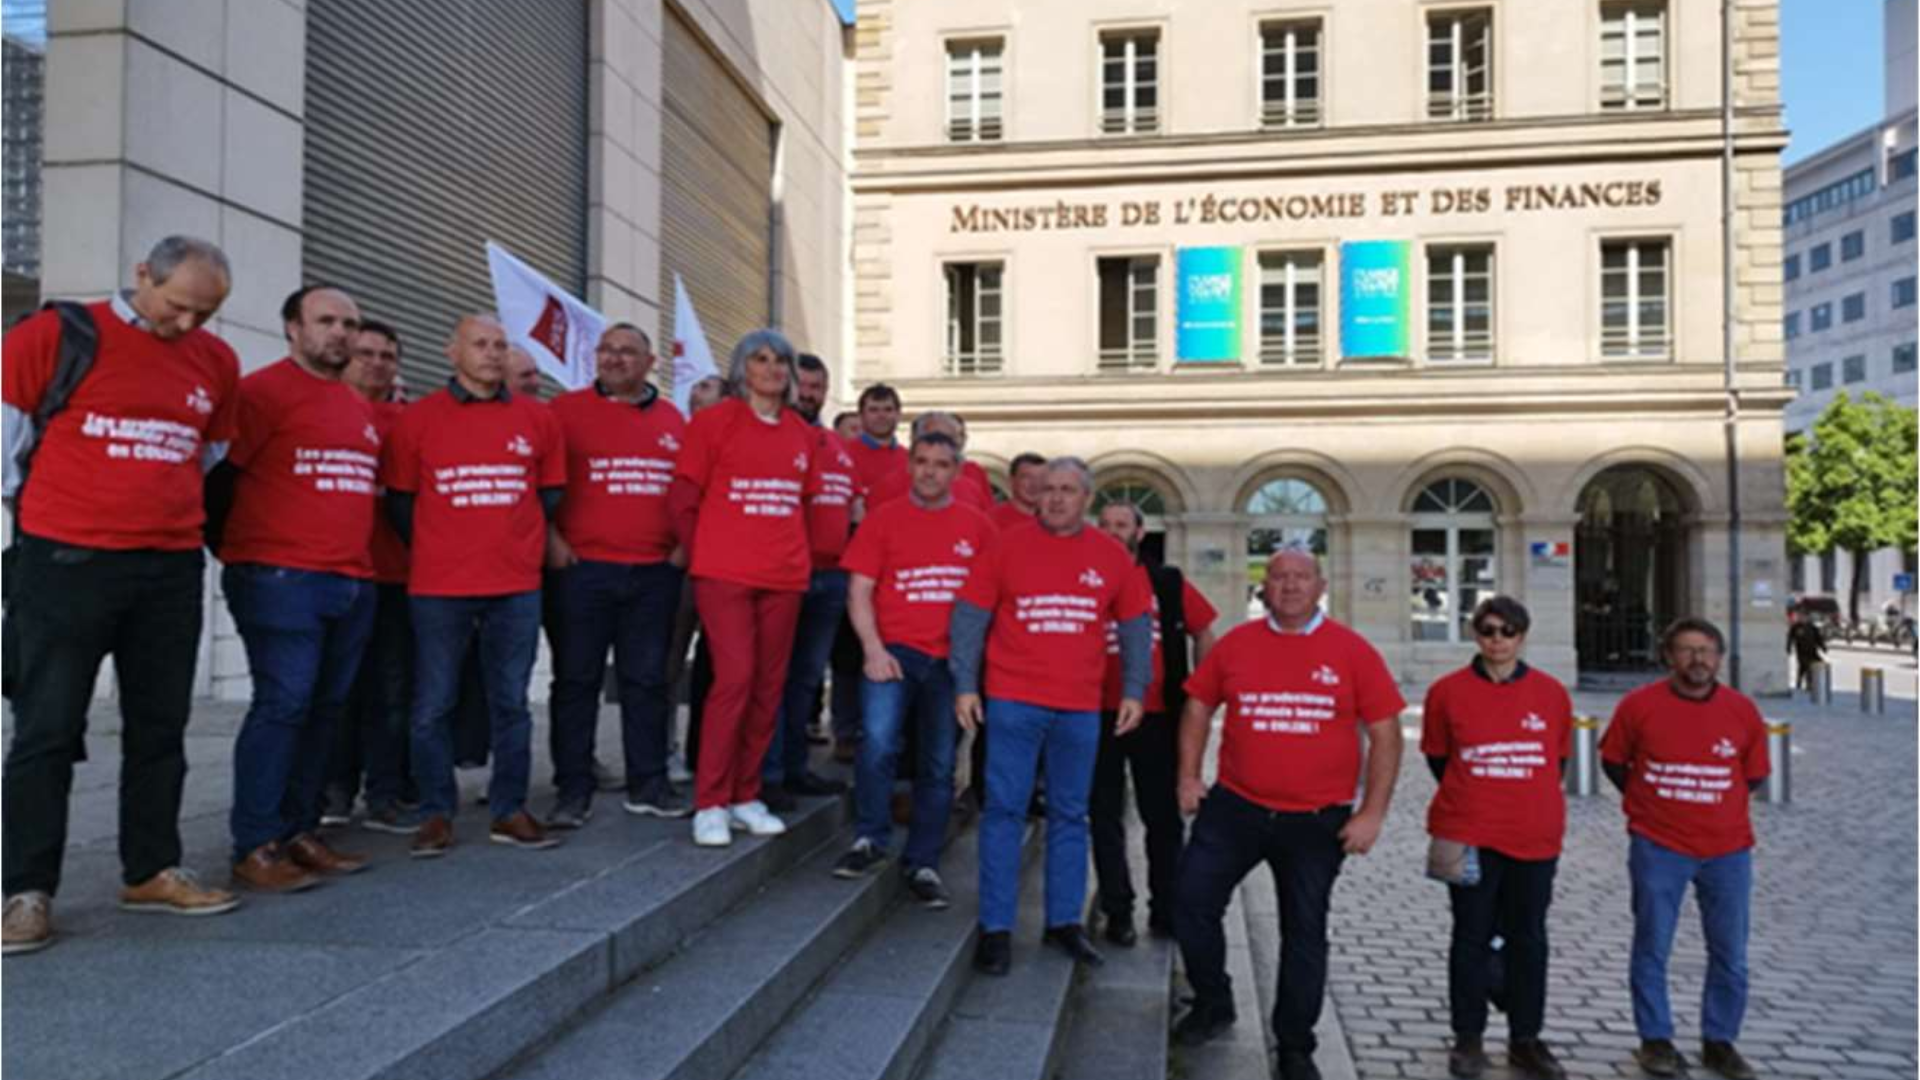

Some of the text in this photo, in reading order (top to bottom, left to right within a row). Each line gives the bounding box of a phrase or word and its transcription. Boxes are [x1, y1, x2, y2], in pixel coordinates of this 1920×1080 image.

[951, 179, 1663, 233] MINISTÈRE DE L'ÉCONOMIE ET DES FINANCES
